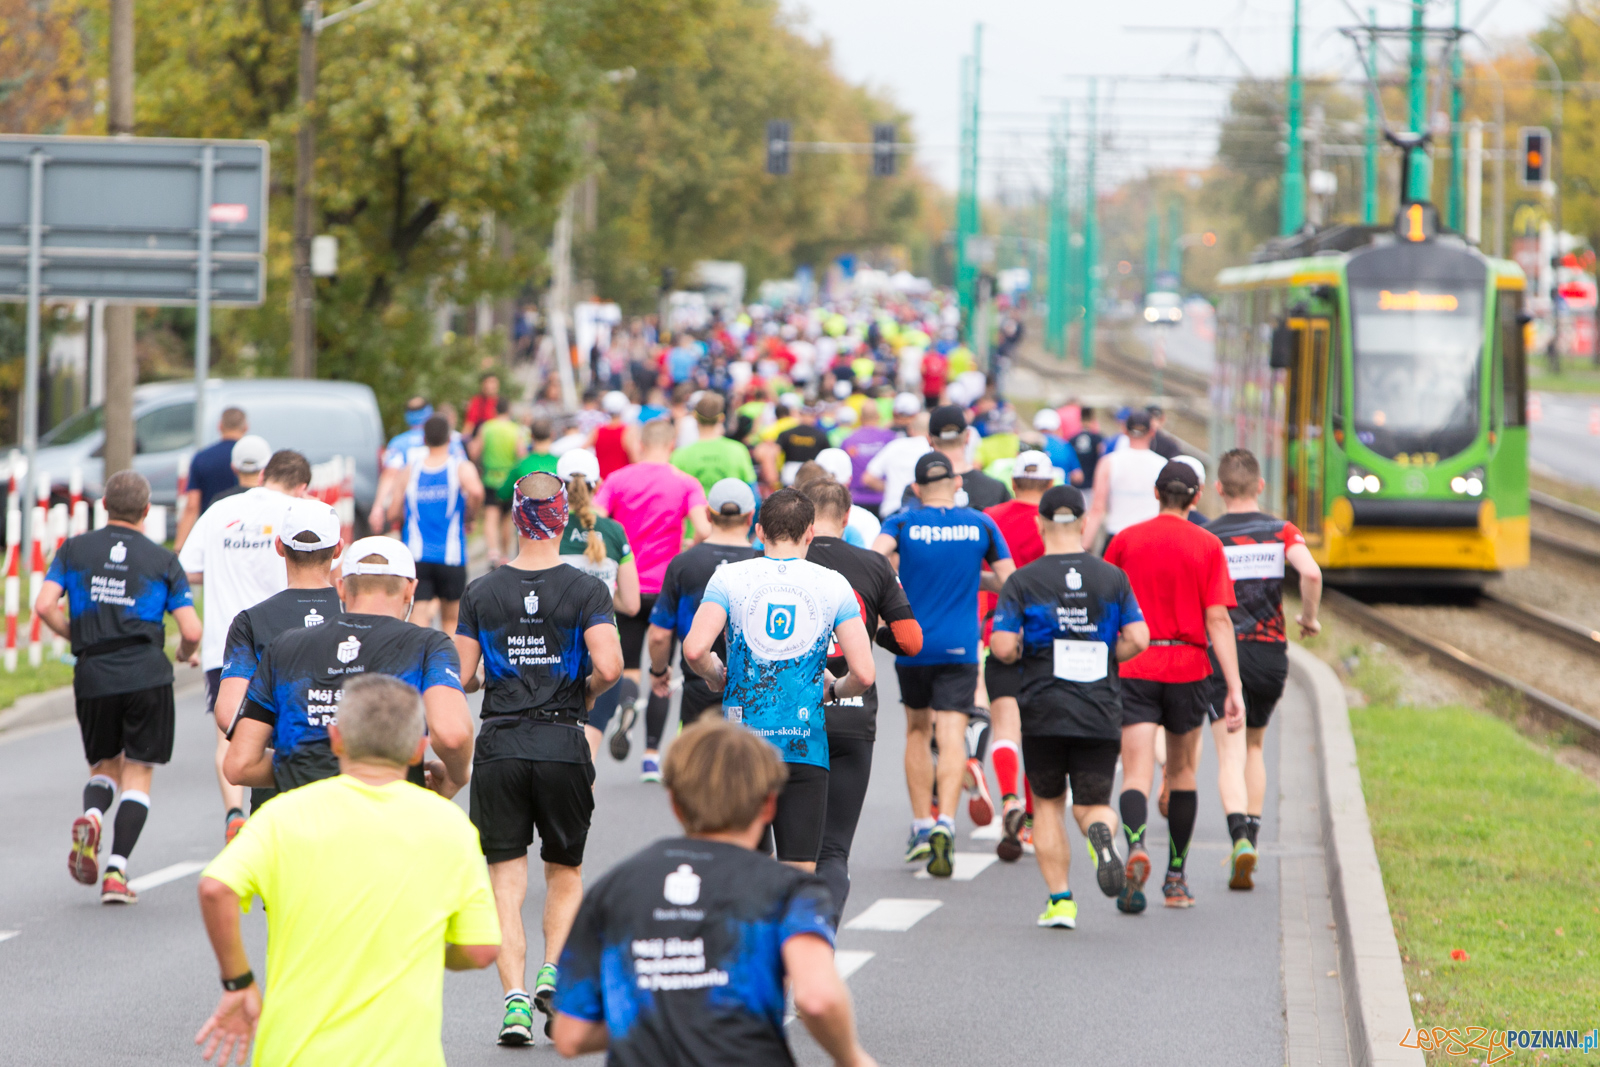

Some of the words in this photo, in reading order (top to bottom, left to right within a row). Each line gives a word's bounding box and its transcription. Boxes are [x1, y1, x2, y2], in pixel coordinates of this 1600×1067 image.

[1407, 204, 1425, 241] 1
[224, 536, 271, 549] Robert
[774, 586, 803, 598] GMINA
[803, 595, 817, 620] SKOKI
[507, 636, 525, 647] Mój
[527, 635, 545, 646] ślad
[508, 646, 547, 657] pozostał
[519, 654, 561, 665] Poznaniu
[328, 667, 344, 675] Bank
[345, 665, 364, 674] Polski
[308, 689, 332, 704] Mój
[307, 717, 320, 726] w
